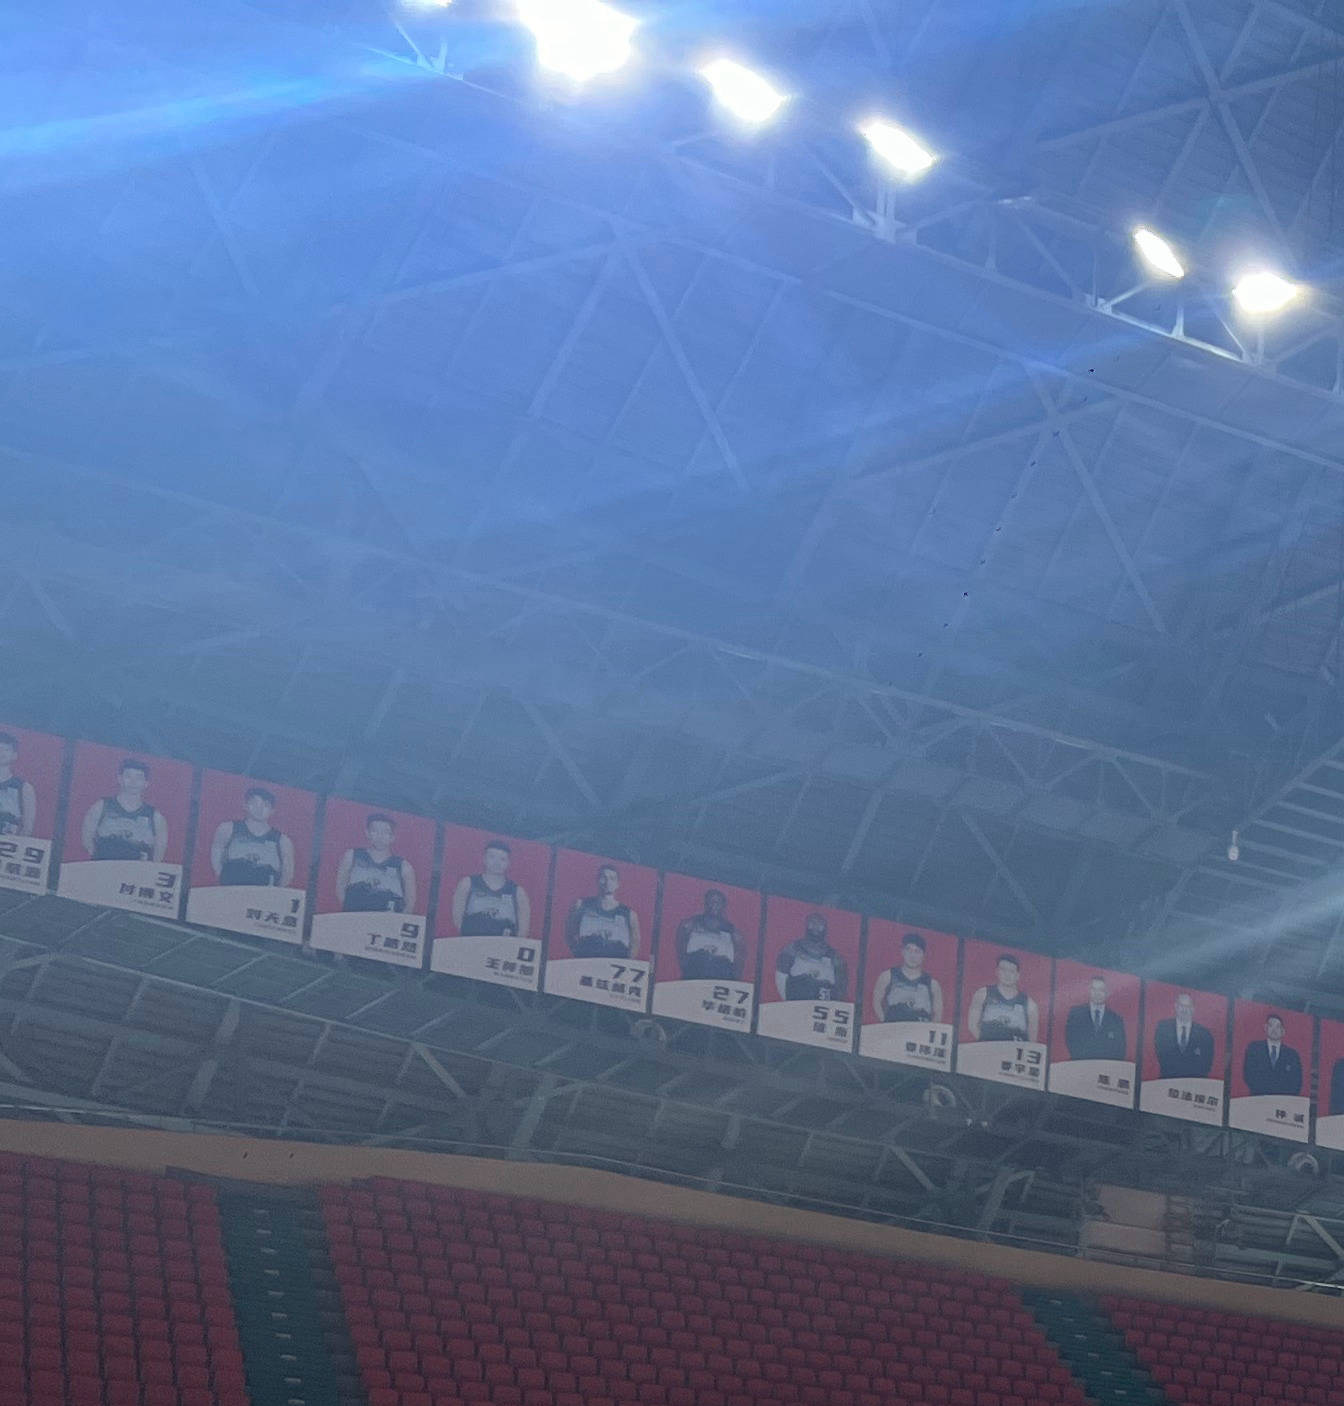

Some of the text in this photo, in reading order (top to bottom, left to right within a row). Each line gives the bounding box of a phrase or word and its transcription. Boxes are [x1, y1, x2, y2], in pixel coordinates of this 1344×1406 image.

[609, 963, 645, 983] 77
[712, 985, 750, 1005] 27
[811, 1005, 849, 1025] 55
[1015, 1047, 1041, 1065] 13
